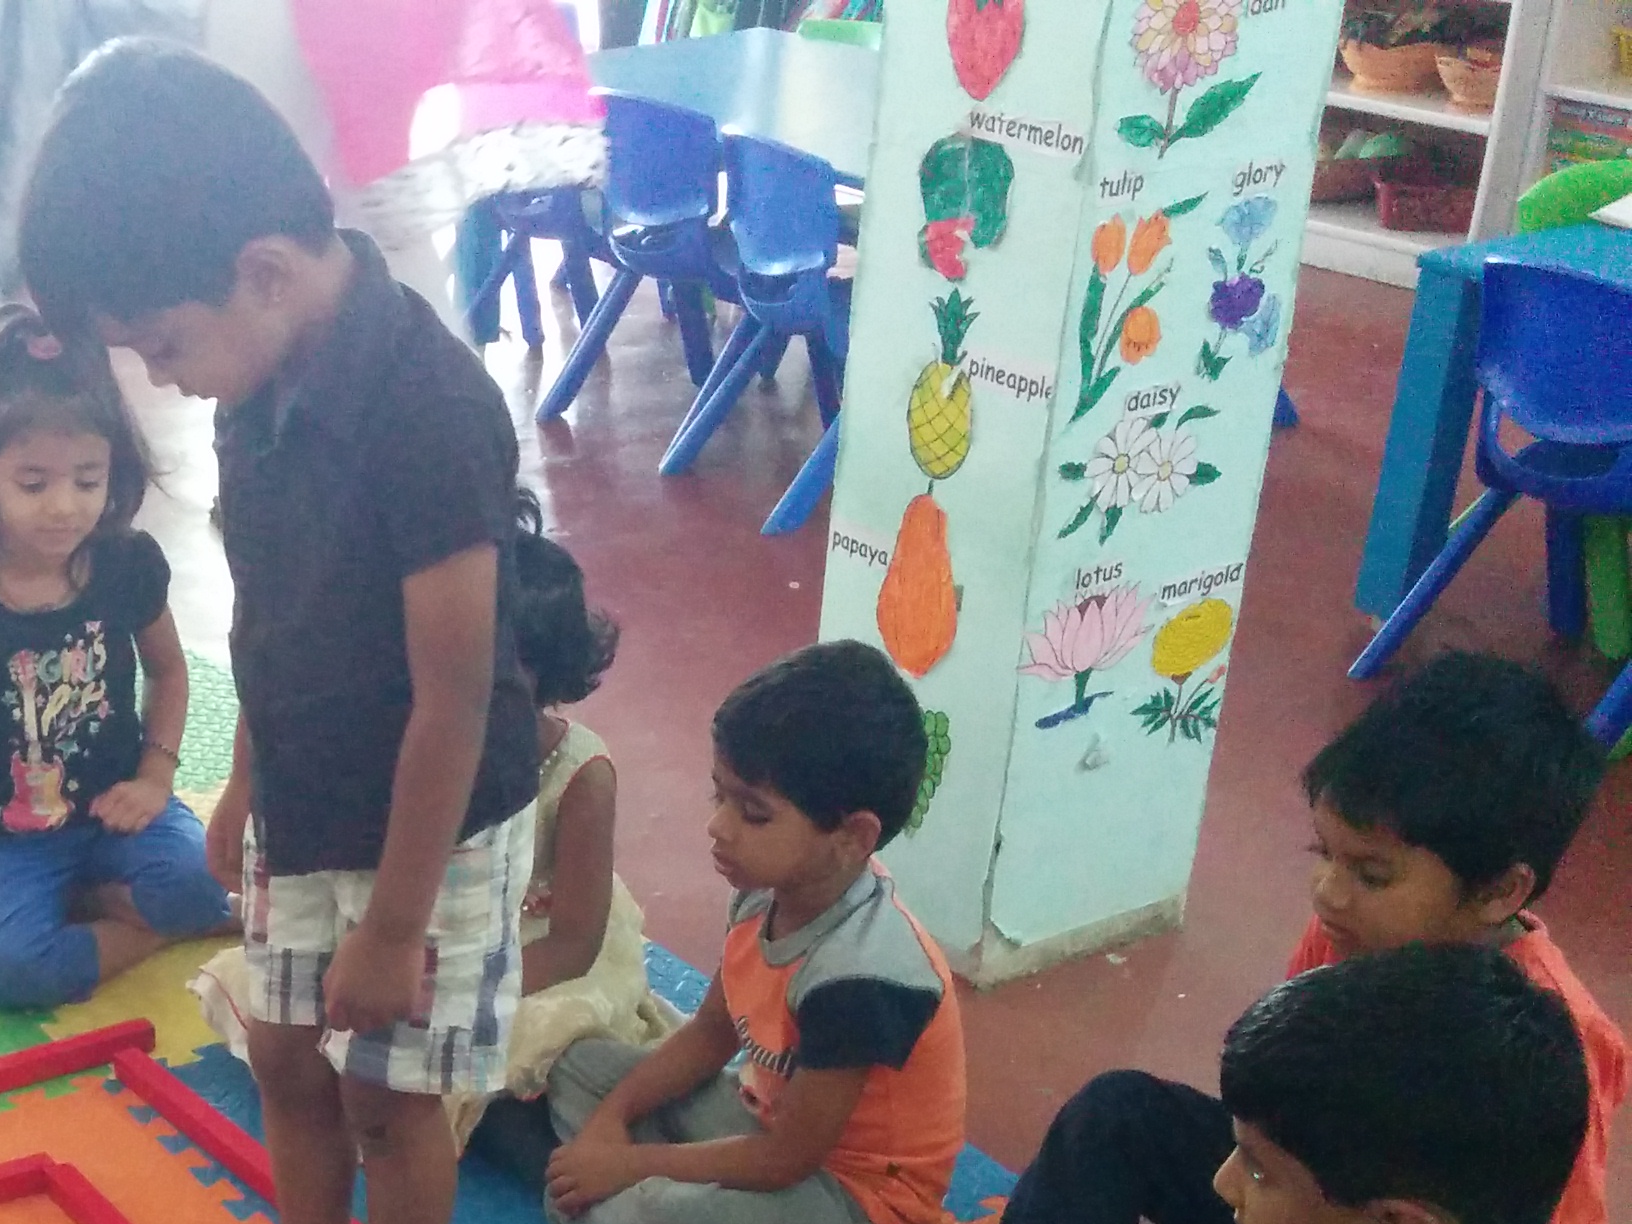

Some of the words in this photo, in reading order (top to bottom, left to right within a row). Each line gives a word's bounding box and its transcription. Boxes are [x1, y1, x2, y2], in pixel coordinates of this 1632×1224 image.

[968, 111, 1085, 155] watermelon
[1099, 170, 1145, 201] tulip
[1232, 160, 1286, 197] glory
[968, 357, 1053, 403] pineapple
[1126, 381, 1182, 412] daisy
[831, 530, 889, 568] papaya
[1075, 562, 1123, 590] lotus
[1160, 562, 1244, 600] marigold
